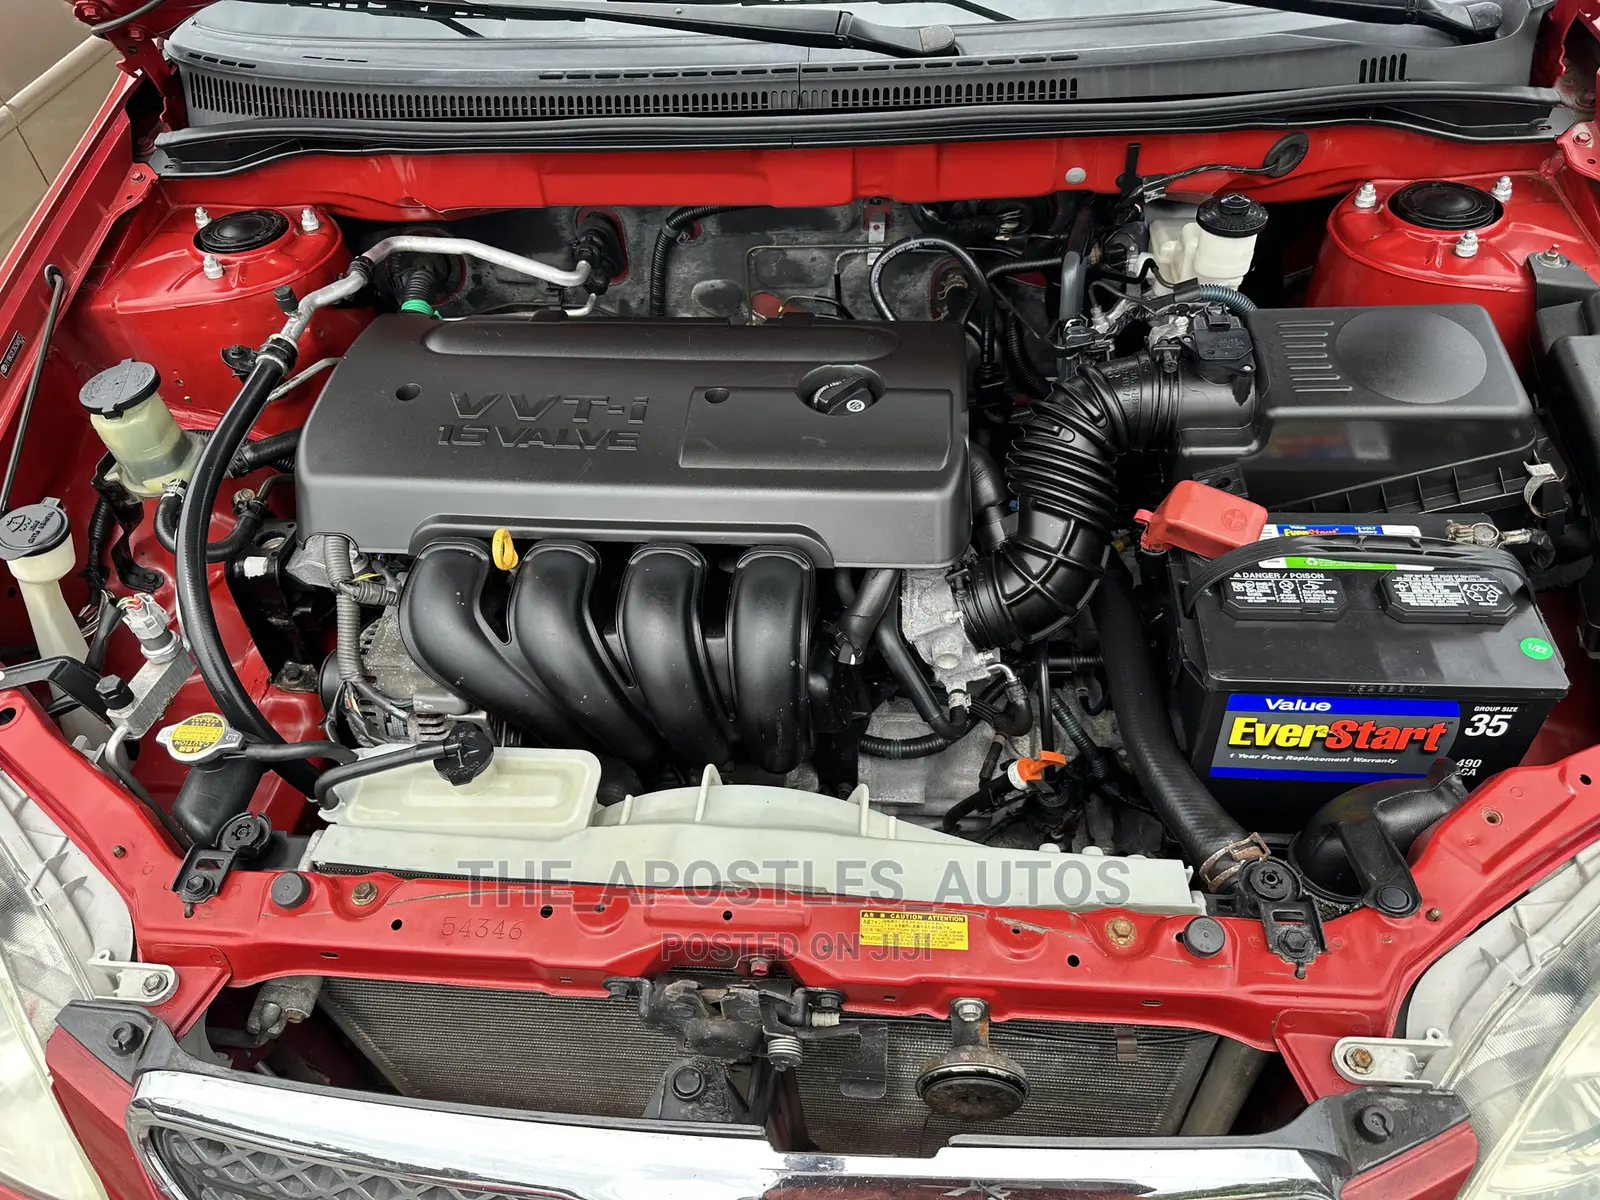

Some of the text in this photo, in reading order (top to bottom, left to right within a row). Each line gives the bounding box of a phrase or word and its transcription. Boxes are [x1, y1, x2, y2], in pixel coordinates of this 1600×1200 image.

[450, 391, 649, 424] VVT-i
[438, 424, 640, 451] 16 VALVE
[1265, 698, 1332, 712] Value
[1228, 717, 1449, 752] EverStart
[1464, 713, 1513, 737] 35
[1353, 756, 1398, 764] Warranty
[1456, 758, 1483, 768] 490
[440, 915, 524, 941] 54346
[890, 912, 923, 921] CAUTION
[927, 915, 964, 923] ATTENTION
